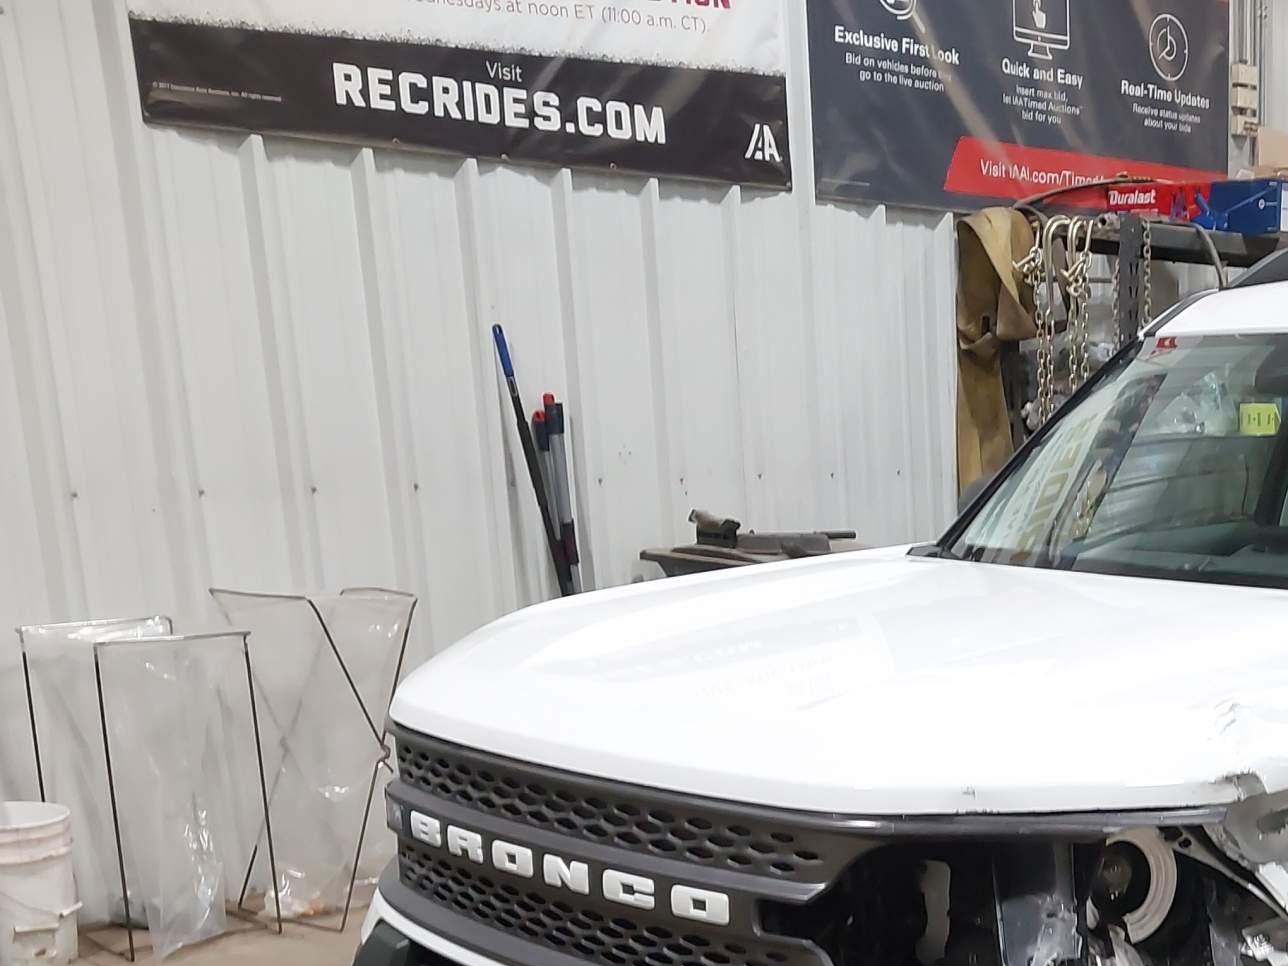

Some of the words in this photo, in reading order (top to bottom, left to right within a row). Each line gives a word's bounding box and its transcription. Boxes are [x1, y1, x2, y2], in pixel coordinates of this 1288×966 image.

[506, 1, 523, 13] at
[528, 3, 569, 17] noon
[574, 4, 595, 19] ET
[601, 6, 642, 25] (11:00
[646, 14, 677, 29] a.m.
[681, 15, 710, 34] CT).
[834, 25, 899, 53] Exclusive
[901, 37, 930, 59] First
[485, 60, 523, 83] Visit
[845, 52, 862, 65] Bid
[863, 57, 875, 67] on
[876, 59, 909, 74] vehicles
[910, 63, 937, 78] before
[1002, 58, 1030, 79] Quick
[1033, 67, 1054, 82] and
[1057, 68, 1083, 90] Easy
[860, 70, 871, 82] go
[873, 70, 883, 82] to
[884, 72, 898, 85] the
[899, 74, 913, 88] live
[914, 79, 945, 93] auction
[1120, 79, 1173, 103] Real-Time
[1174, 88, 1210, 110] Updates
[332, 62, 667, 145] RECRIDES.COM
[1022, 110, 1033, 121] bid
[1035, 111, 1047, 122] for
[1047, 114, 1061, 125] you
[980, 159, 1006, 178] Visit
[1109, 189, 1156, 206] Duralast
[409, 809, 730, 927] BRONCO
